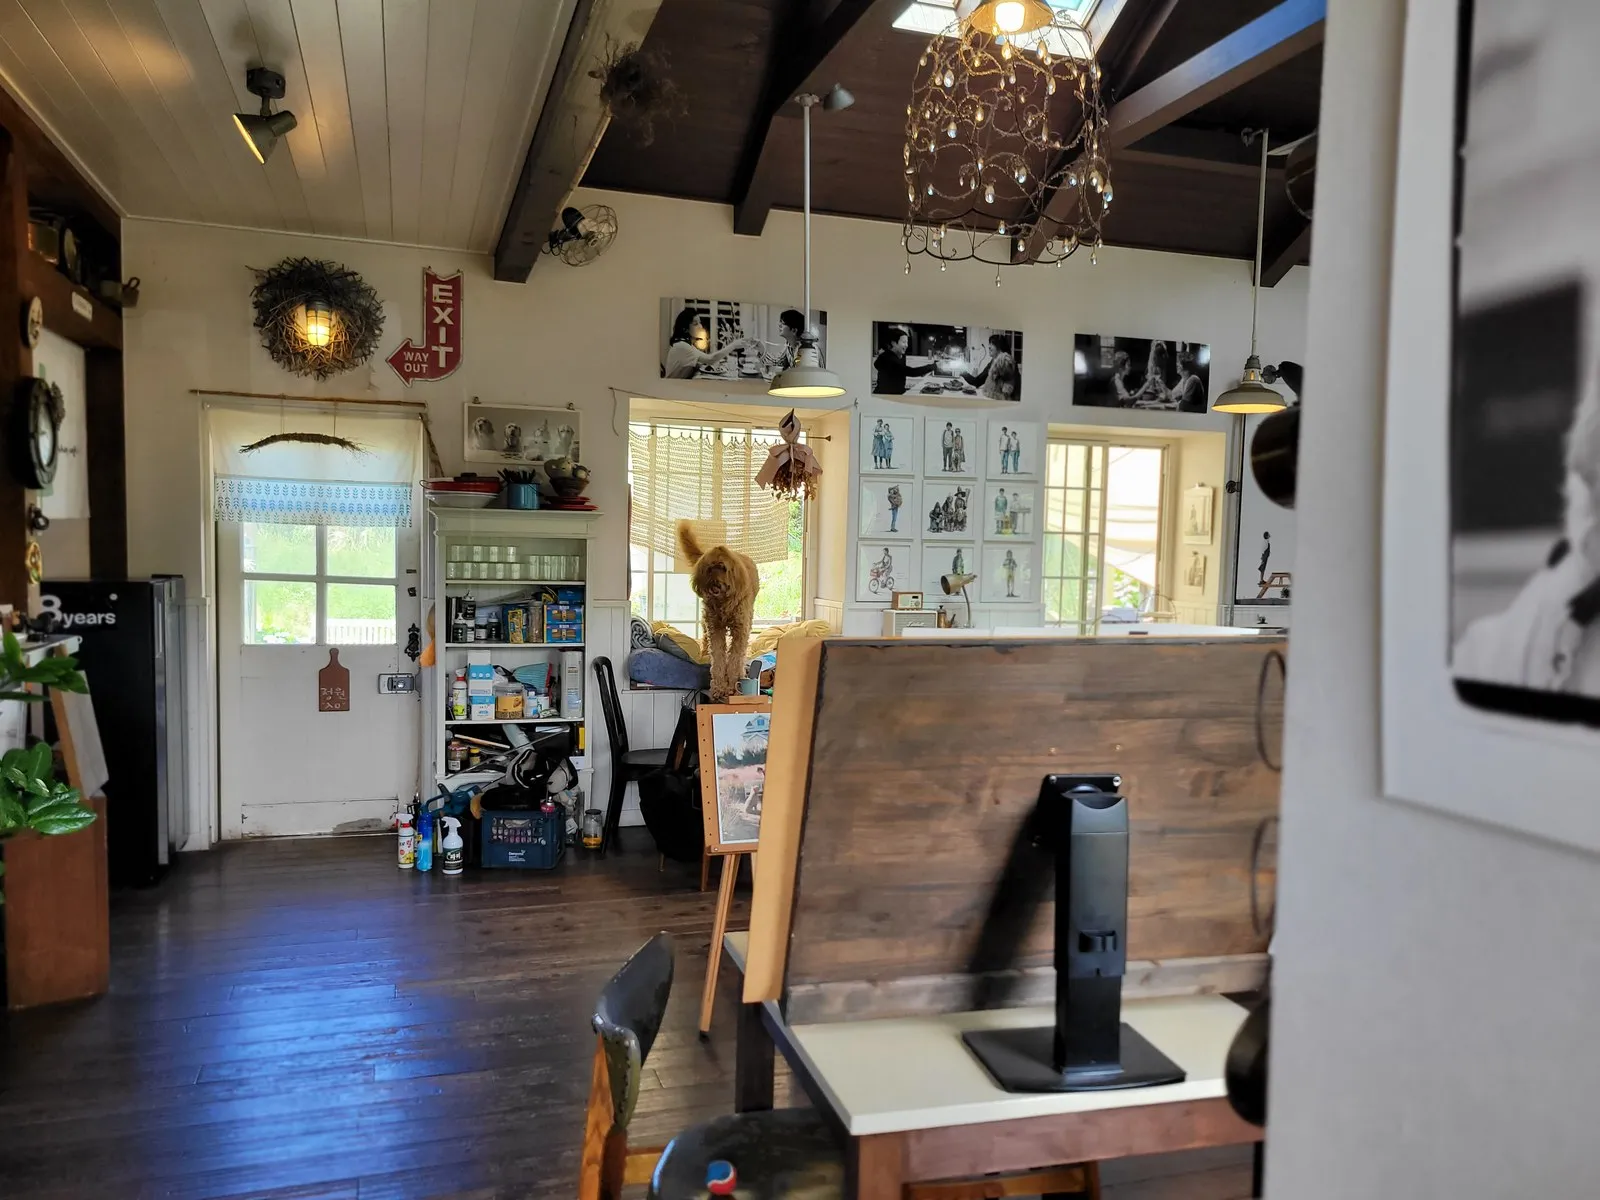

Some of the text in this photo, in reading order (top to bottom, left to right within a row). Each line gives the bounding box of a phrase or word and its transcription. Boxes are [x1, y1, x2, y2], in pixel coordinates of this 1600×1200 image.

[432, 283, 454, 368] EXIT
[403, 351, 429, 363] WAY
[404, 363, 429, 374] OUT
[62, 612, 117, 629] years
